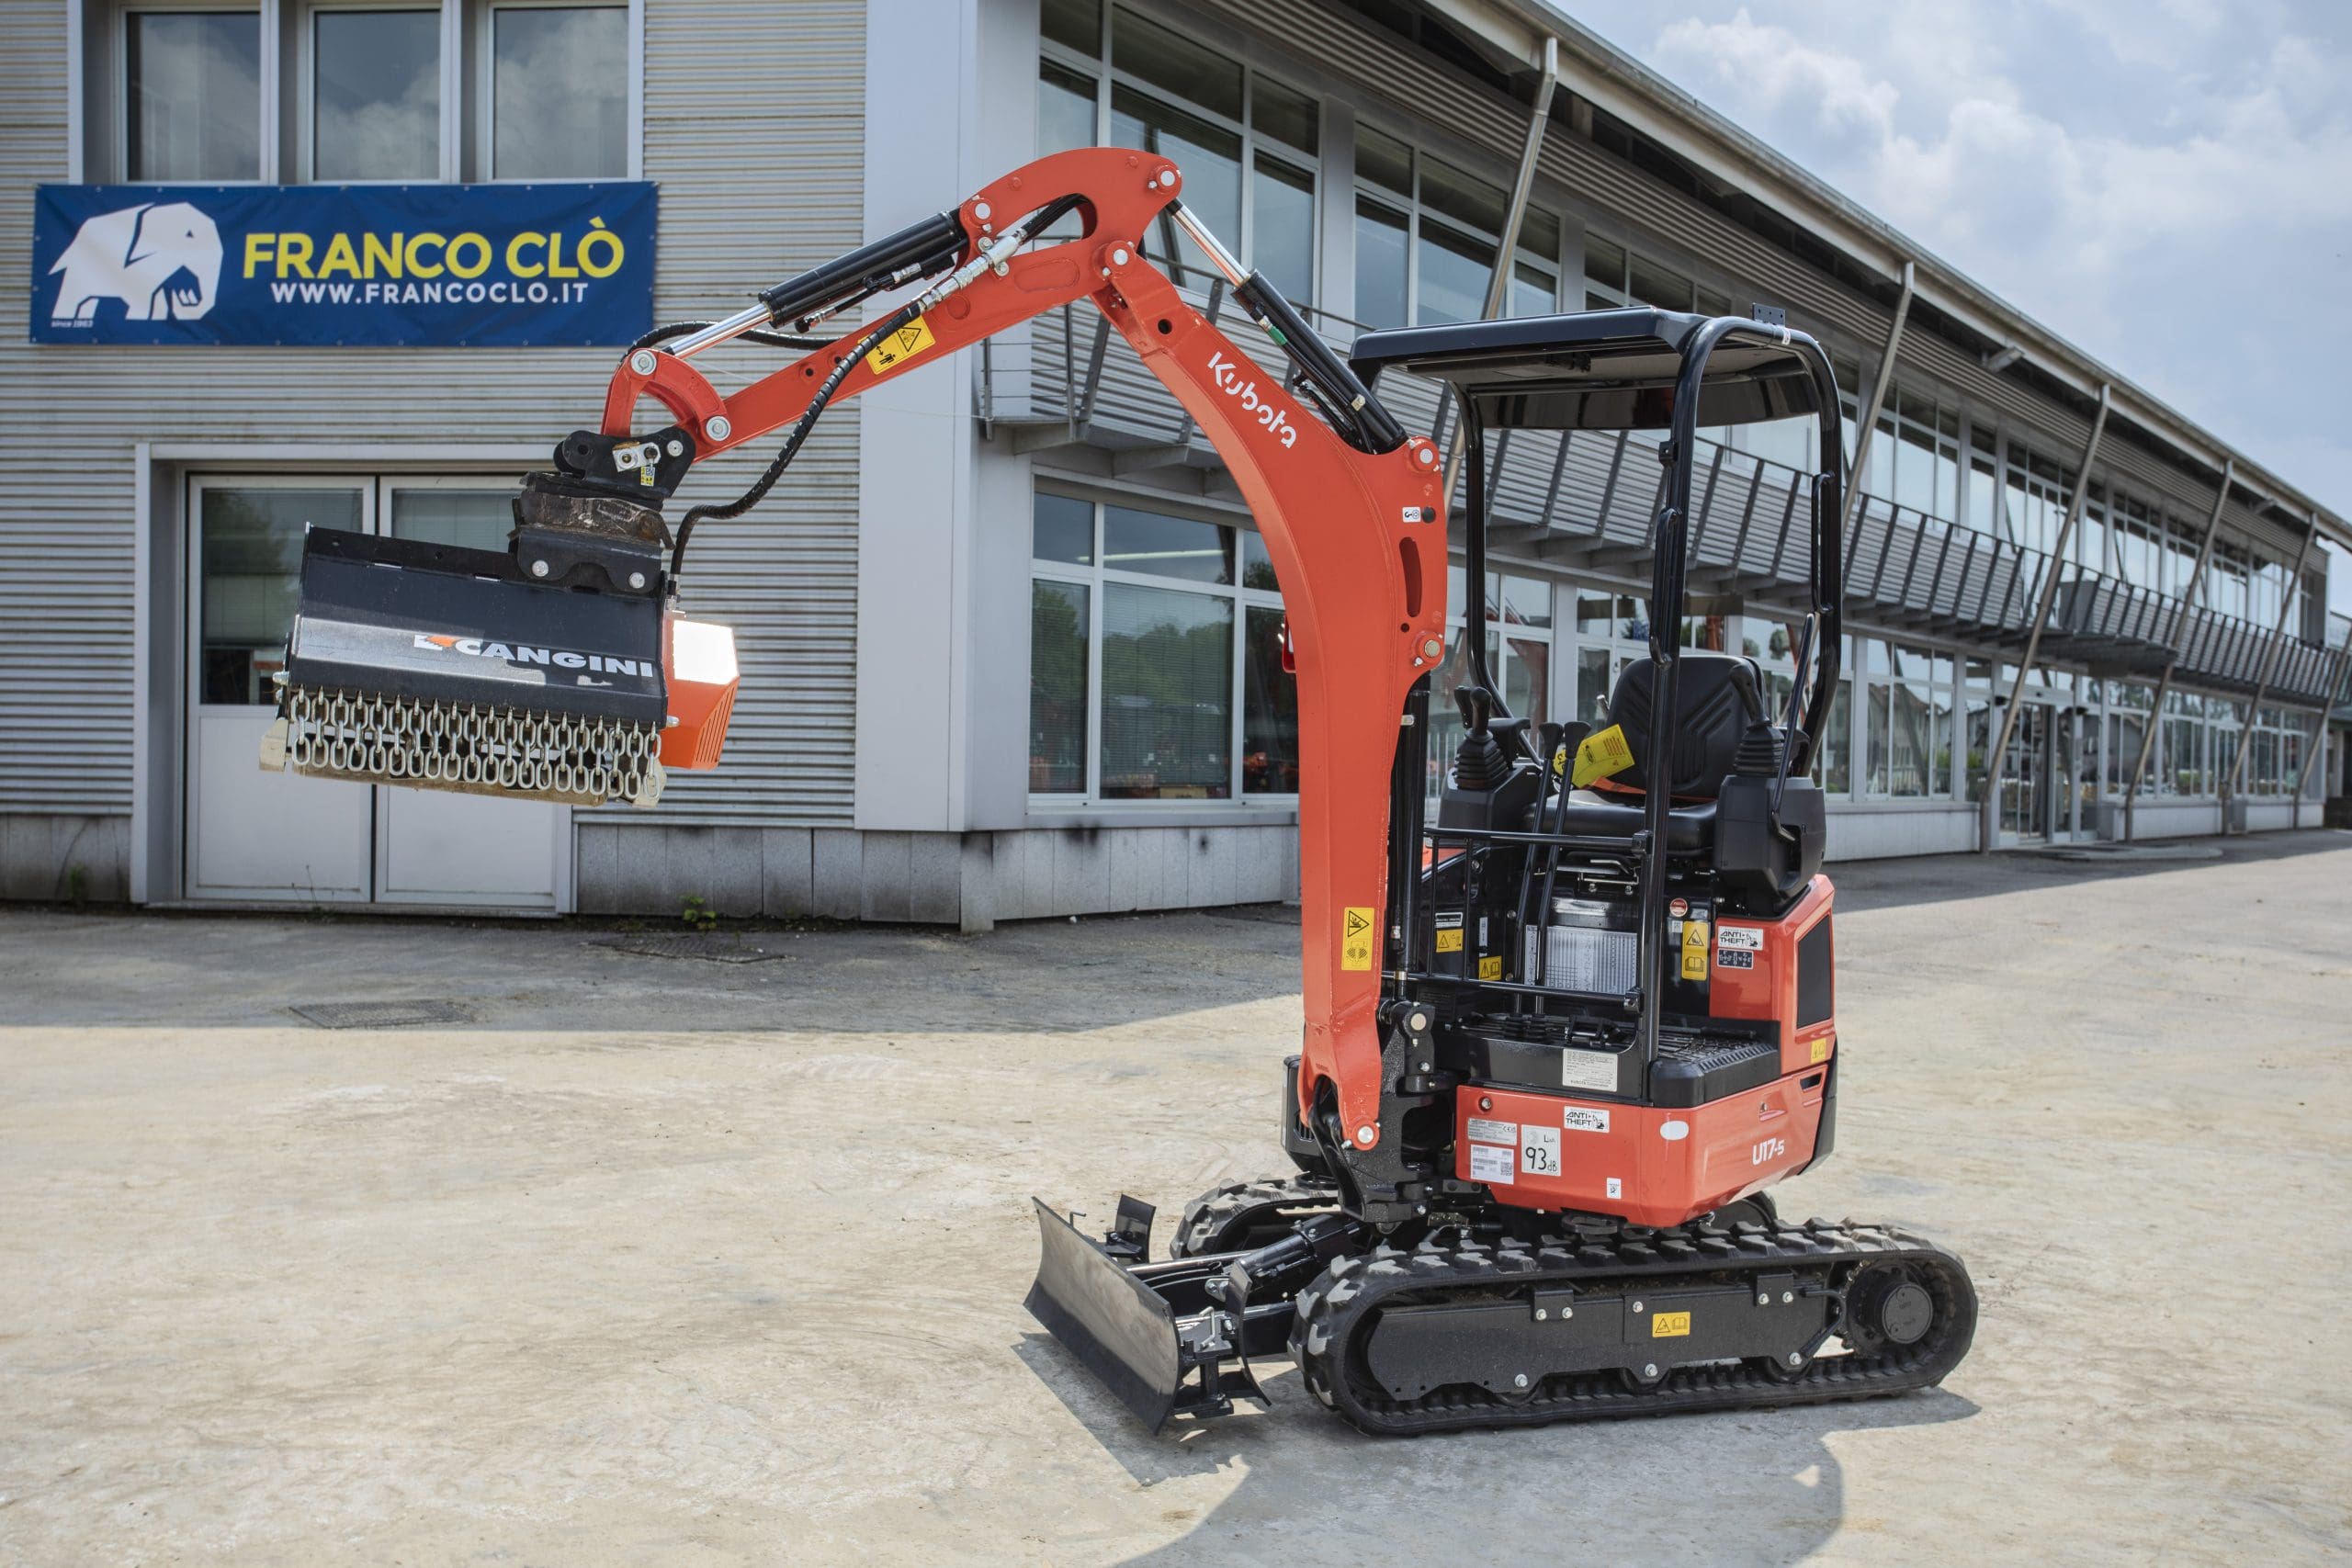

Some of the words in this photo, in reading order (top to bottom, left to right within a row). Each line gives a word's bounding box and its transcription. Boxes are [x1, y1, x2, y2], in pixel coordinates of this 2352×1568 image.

[243, 232, 492, 279] FRANCO
[506, 216, 625, 278] CLÒ
[271, 283, 589, 303] WWW.FRANCOCLO.IT
[1207, 351, 1297, 448] Kubota
[455, 638, 654, 678] CANGINI
[1566, 1118, 1592, 1126] THEFT
[1525, 1146, 1547, 1170] 93
[1547, 1160, 1557, 1172] dB
[1752, 1137, 1785, 1166] U17-5
